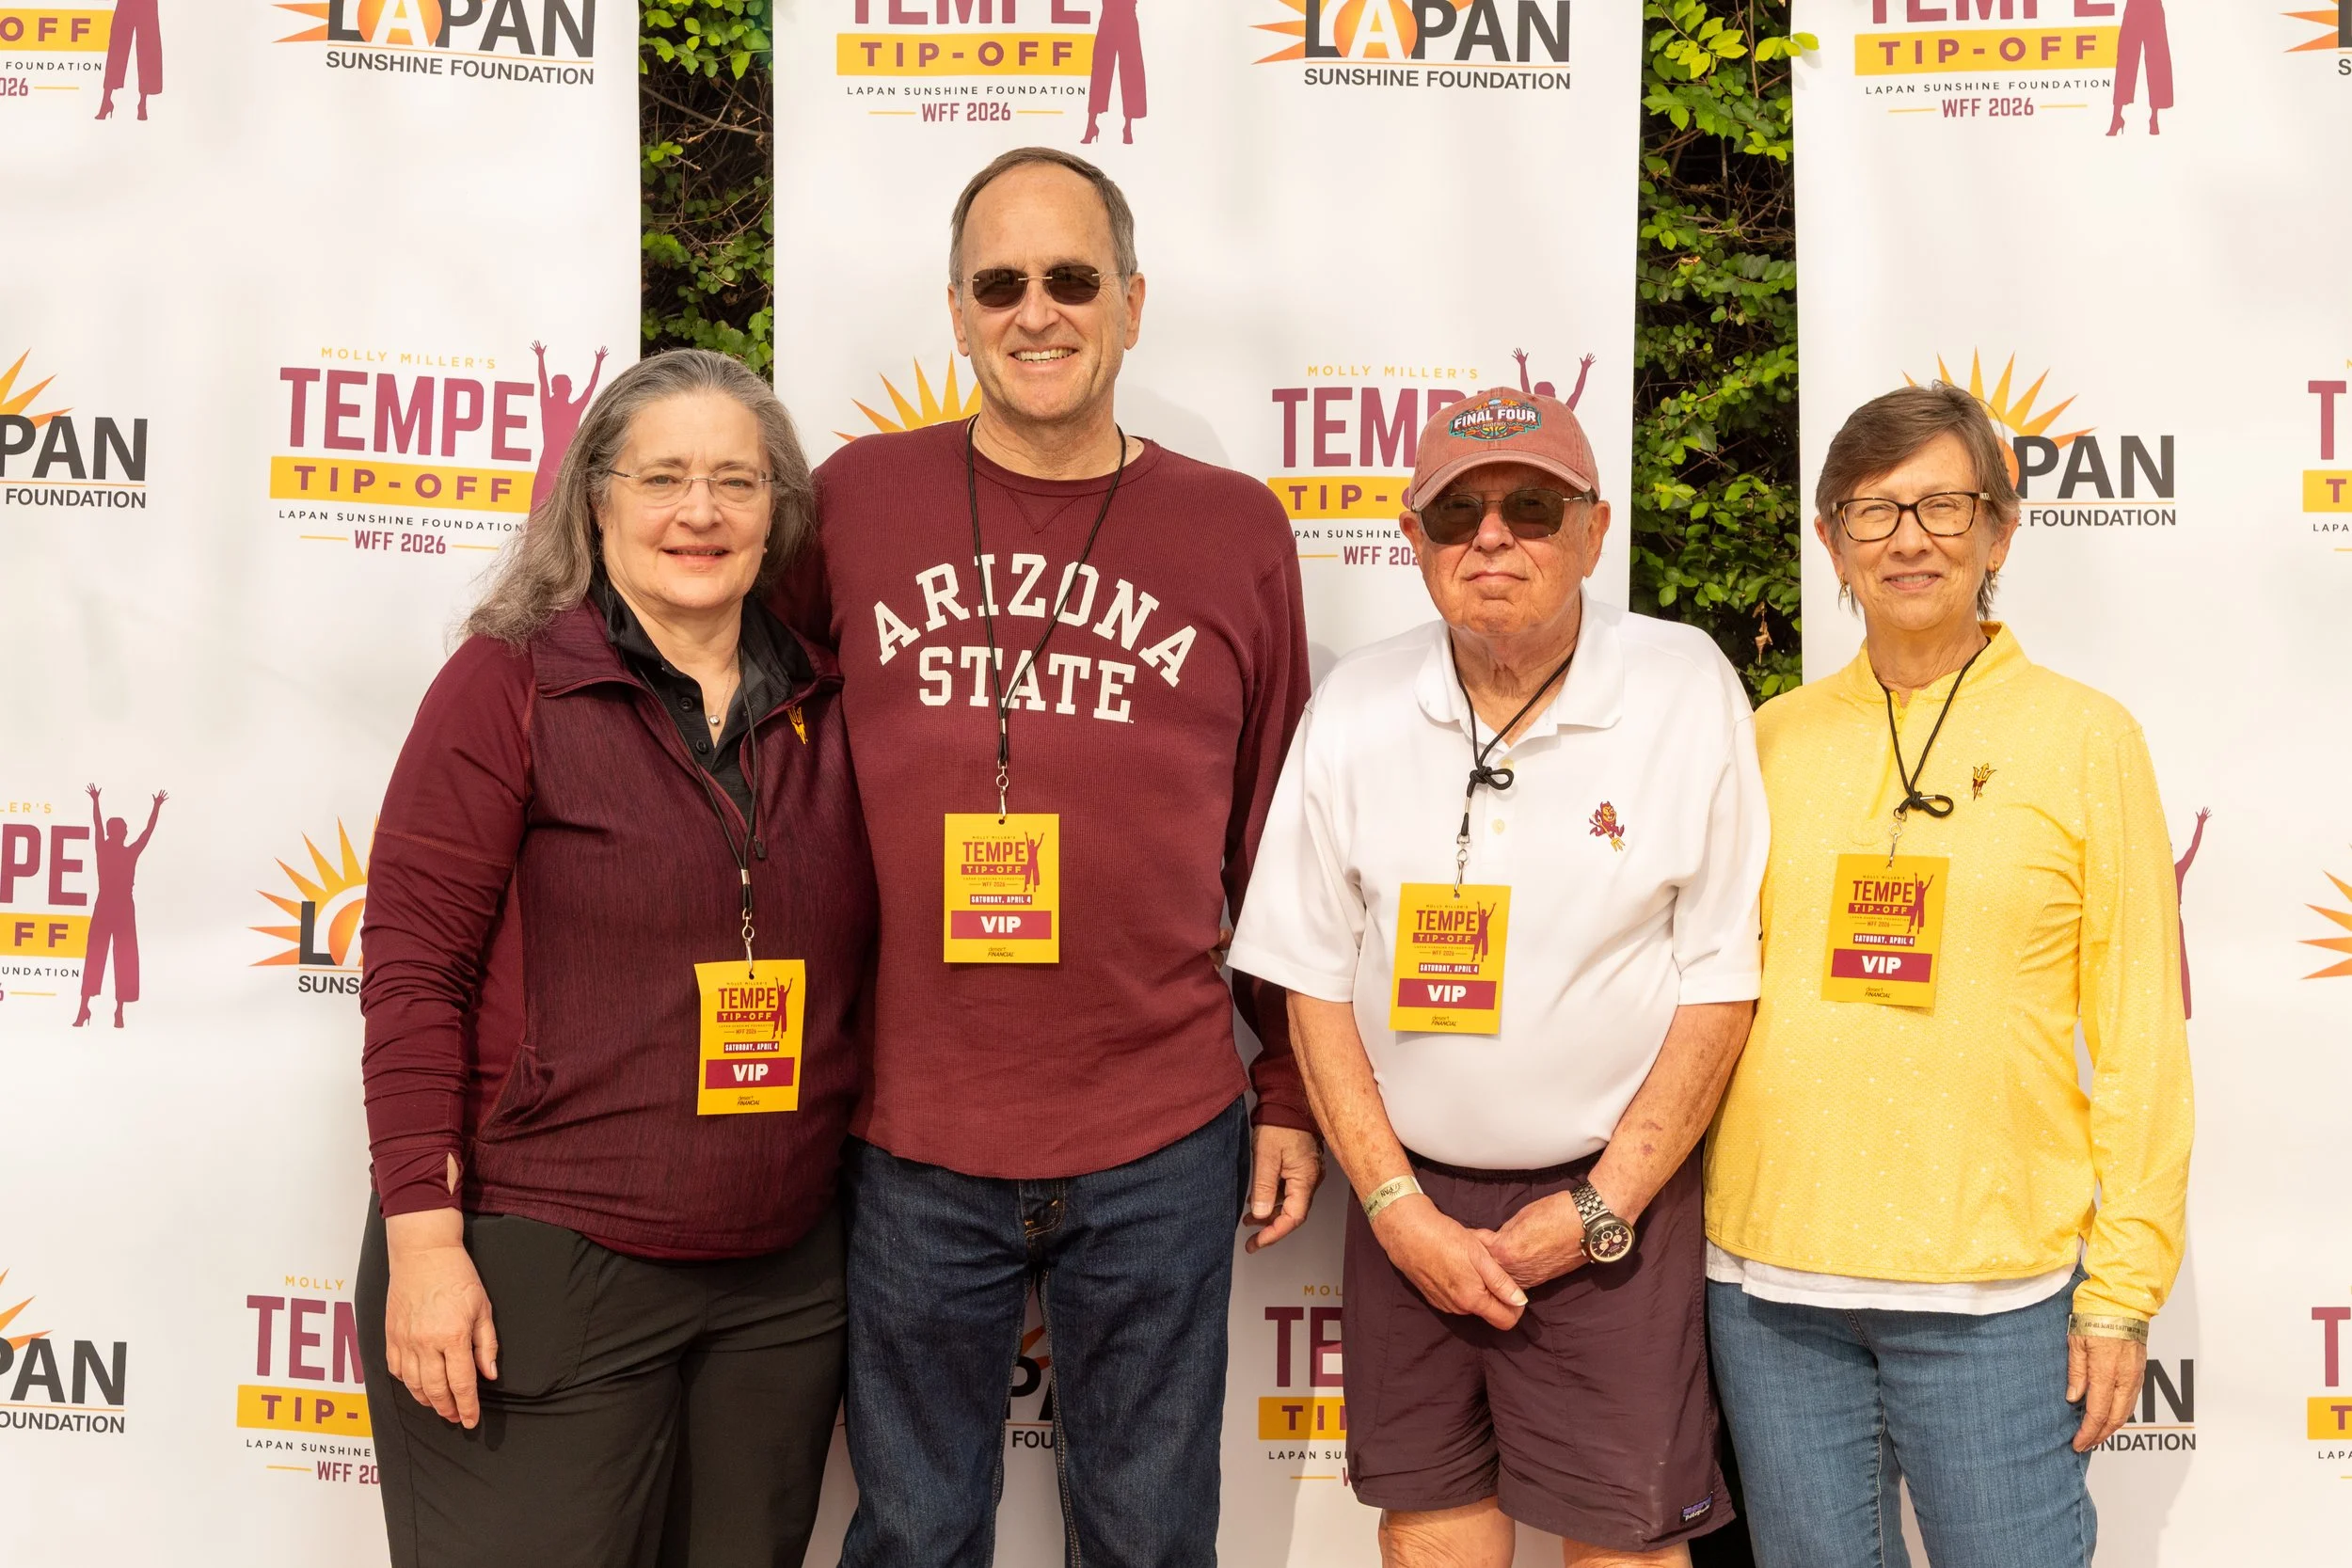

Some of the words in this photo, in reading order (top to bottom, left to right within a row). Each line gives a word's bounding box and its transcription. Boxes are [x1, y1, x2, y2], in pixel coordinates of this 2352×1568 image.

[327, 0, 596, 57] LAPAN
[1305, 0, 1571, 62] LAPAN
[860, 41, 1073, 68] TIP-OFF
[1878, 35, 2097, 66] TIP-OFF
[6, 61, 103, 71] FOUNDATION
[326, 51, 443, 74] SUNSHINE
[451, 59, 595, 85] FOUNDATION
[1304, 68, 1420, 87] SUNSHINE
[1426, 71, 1571, 90] FOUNDATION
[1866, 84, 1915, 95] LAPAN
[1924, 81, 2000, 92] SUNSHINE
[2009, 79, 2111, 90] FOUNDATION
[847, 86, 896, 96] LAPAN
[904, 87, 978, 96] SUNSHINE
[987, 86, 1087, 96] FOUNDATION
[921, 103, 961, 122] WFF
[966, 102, 1011, 121] 2026
[1942, 98, 1981, 118] WFF
[1988, 97, 2034, 117] 2026
[321, 347, 388, 362] MOLLY
[400, 353, 497, 370] MILLER'S
[1307, 365, 1371, 377] MOLLY
[1384, 366, 1480, 380] MILLER'S
[279, 367, 535, 463] TEMPE
[1454, 409, 1494, 429] FINAL
[1497, 408, 1536, 421] FOUR
[1272, 387, 1496, 468] TEM
[2013, 435, 2175, 499] PAN
[294, 465, 513, 503] TIP-OFF
[6, 488, 147, 509] FOUNDATION
[278, 509, 328, 520] LAPAN
[337, 512, 414, 526] SUNSHINE
[421, 518, 524, 532] FOUNDATION
[2029, 509, 2177, 527] FOUNDATION
[354, 530, 394, 552] WFF
[401, 532, 446, 555] 2026
[1295, 530, 1320, 539] PAN
[1327, 530, 1401, 539] SUNSHINE
[1343, 546, 1382, 565] WFF
[873, 553, 1198, 688] ARIZONA
[918, 645, 1136, 723] STATE
[962, 842, 1025, 862] TEMPE
[1007, 895, 1025, 904] APRIL
[1026, 895, 1031, 904] 4
[1852, 880, 1915, 903] TEMPE
[1854, 905, 1908, 914] TIP-OFF
[980, 915, 1022, 933] VIP
[1416, 911, 1477, 931] TEMPE
[1419, 934, 1471, 943] TIP-OFF
[1889, 936, 1907, 944] APRIL
[1862, 956, 1902, 974] VIP
[718, 988, 777, 1008] TEMPE
[1427, 985, 1467, 1003] VIP
[722, 1012, 772, 1021] TIP-OFF
[733, 1064, 769, 1082] VIP
[285, 1275, 345, 1291] MOLLY
[246, 1438, 294, 1450] LAPAN
[301, 1442, 371, 1458] SUNSHINE
[1268, 1450, 1317, 1460] LAPAN
[317, 1460, 353, 1482] WFF
